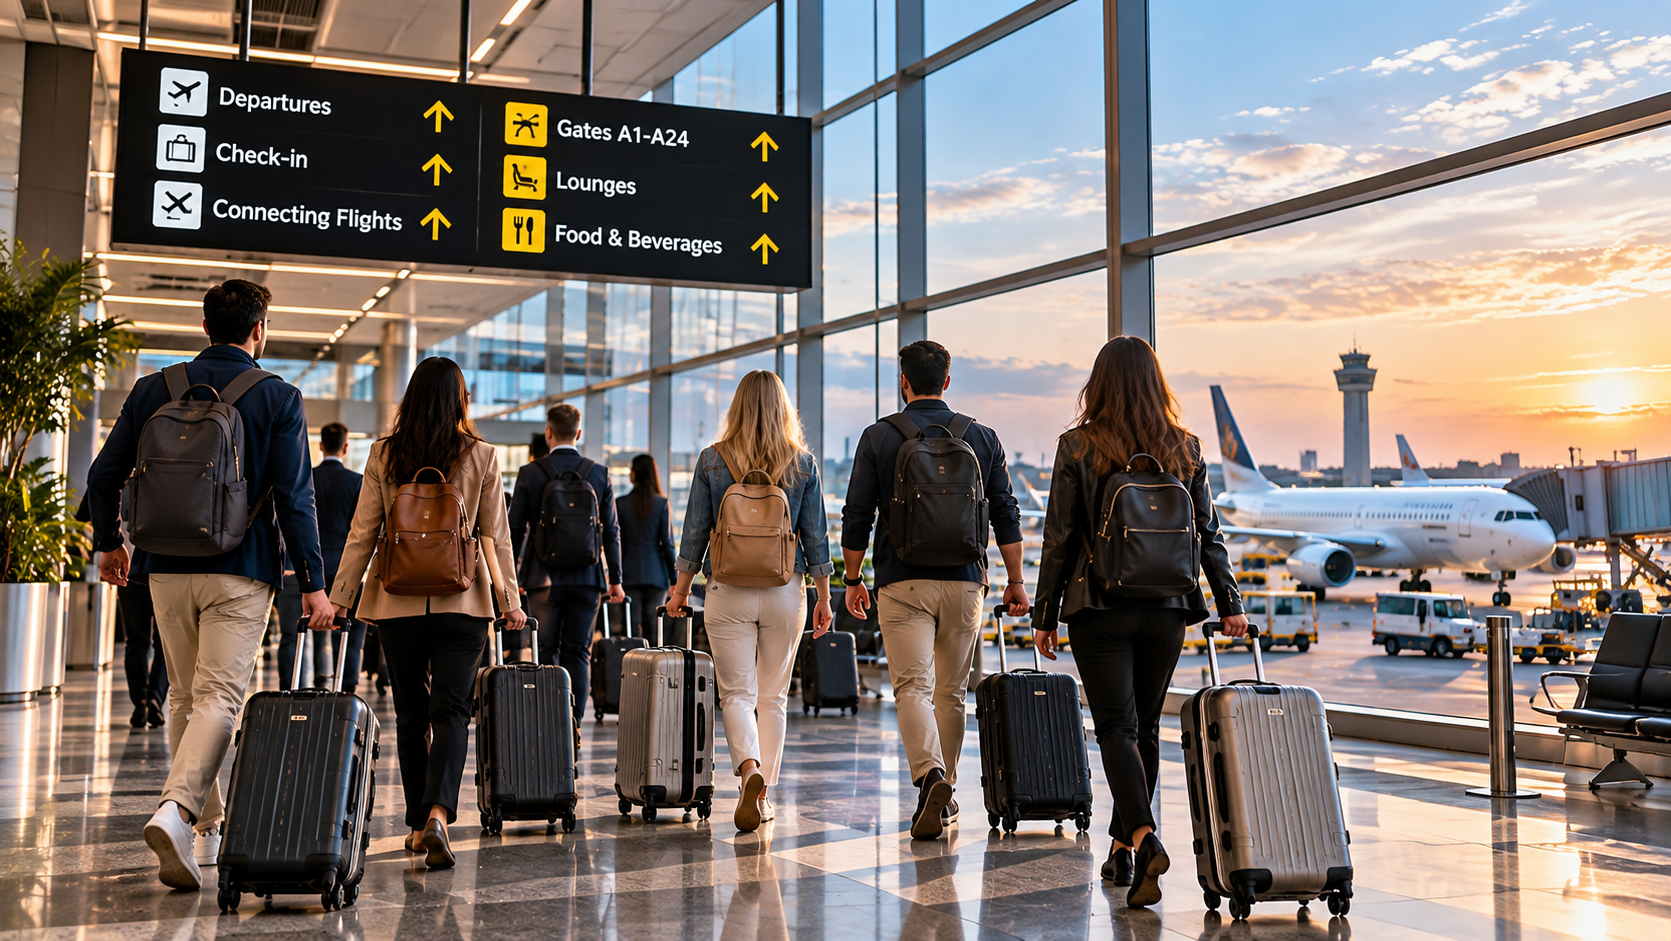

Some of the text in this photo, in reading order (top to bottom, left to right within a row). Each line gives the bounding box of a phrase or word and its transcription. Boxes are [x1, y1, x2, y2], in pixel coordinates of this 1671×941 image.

[219, 86, 332, 116] Departures
[557, 118, 690, 148] Gates A1-A24
[215, 142, 308, 169] Check-in
[556, 171, 637, 198] Lounges
[212, 198, 403, 233] Connecting Flights
[555, 224, 723, 258] Food & Beverages
